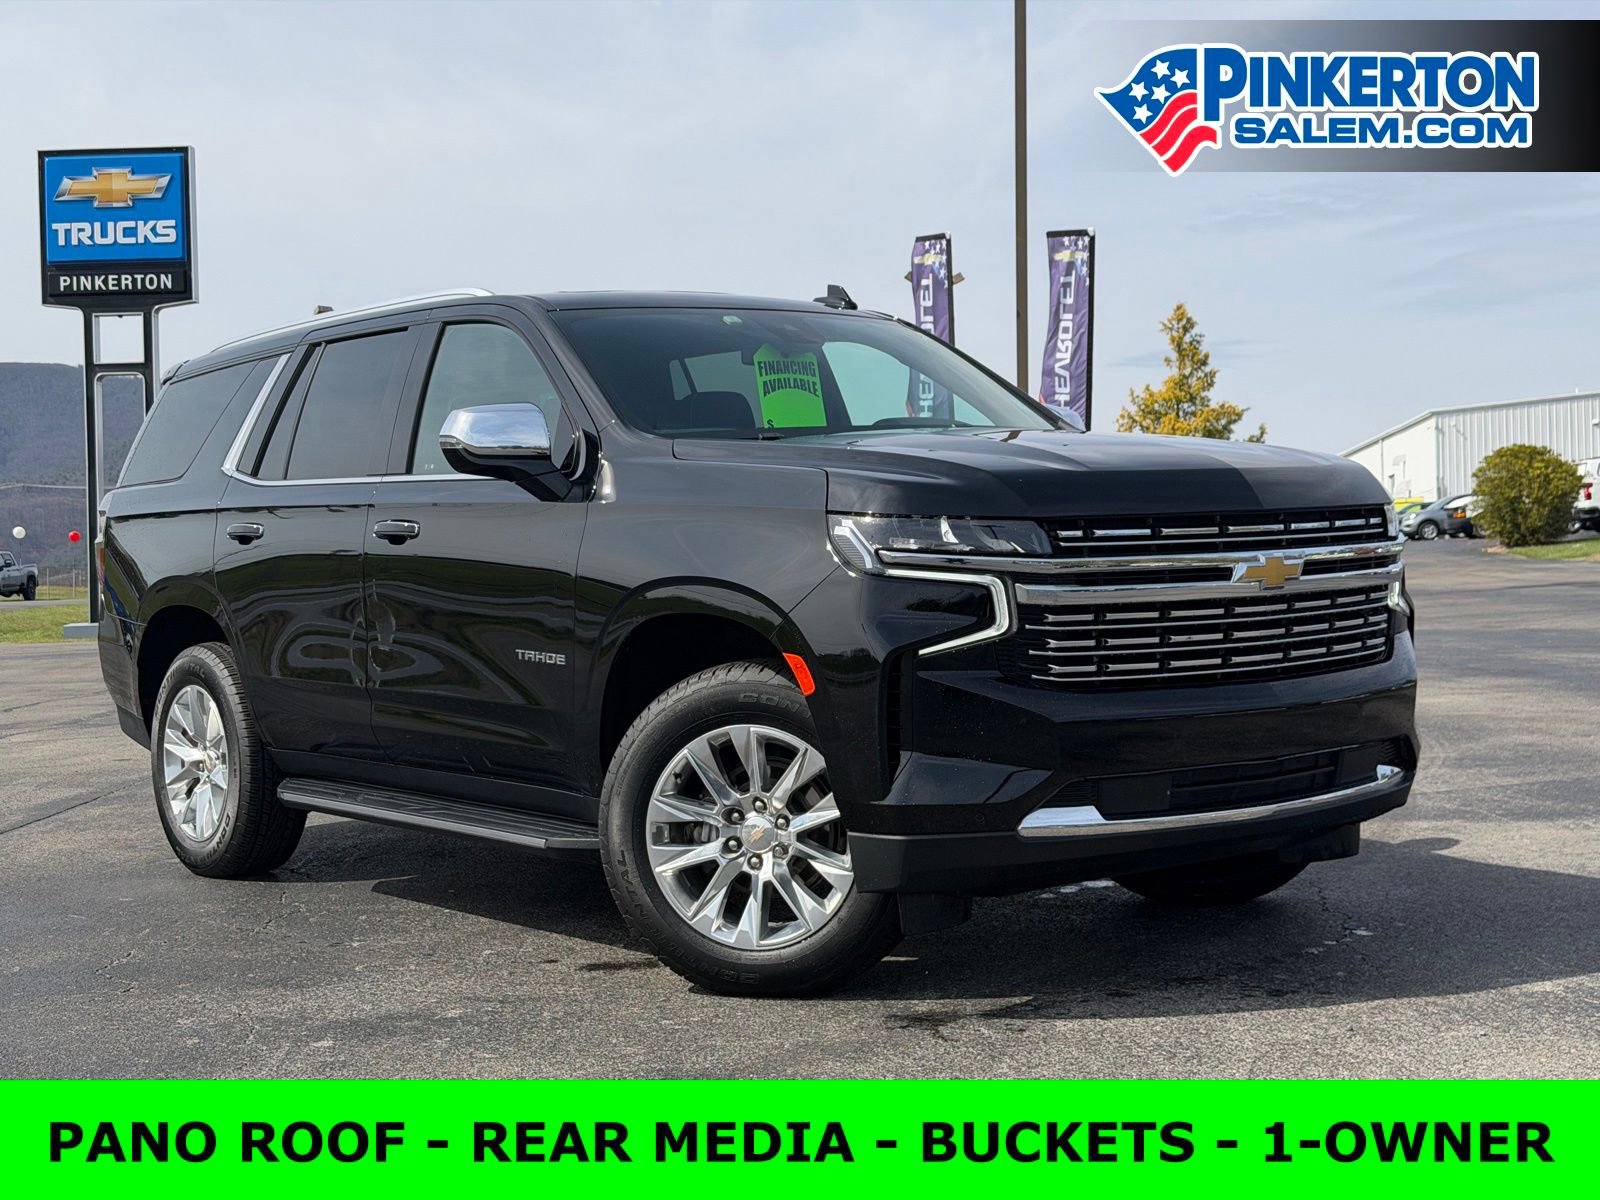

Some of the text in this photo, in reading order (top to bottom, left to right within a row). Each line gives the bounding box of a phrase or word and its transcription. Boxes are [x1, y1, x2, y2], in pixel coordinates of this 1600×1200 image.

[51, 219, 177, 246] TRUCKS
[59, 273, 173, 292] PINKERTON
[757, 360, 817, 377] FINANCING
[762, 377, 820, 398] AVAILABLE
[515, 649, 566, 665] TAHOE
